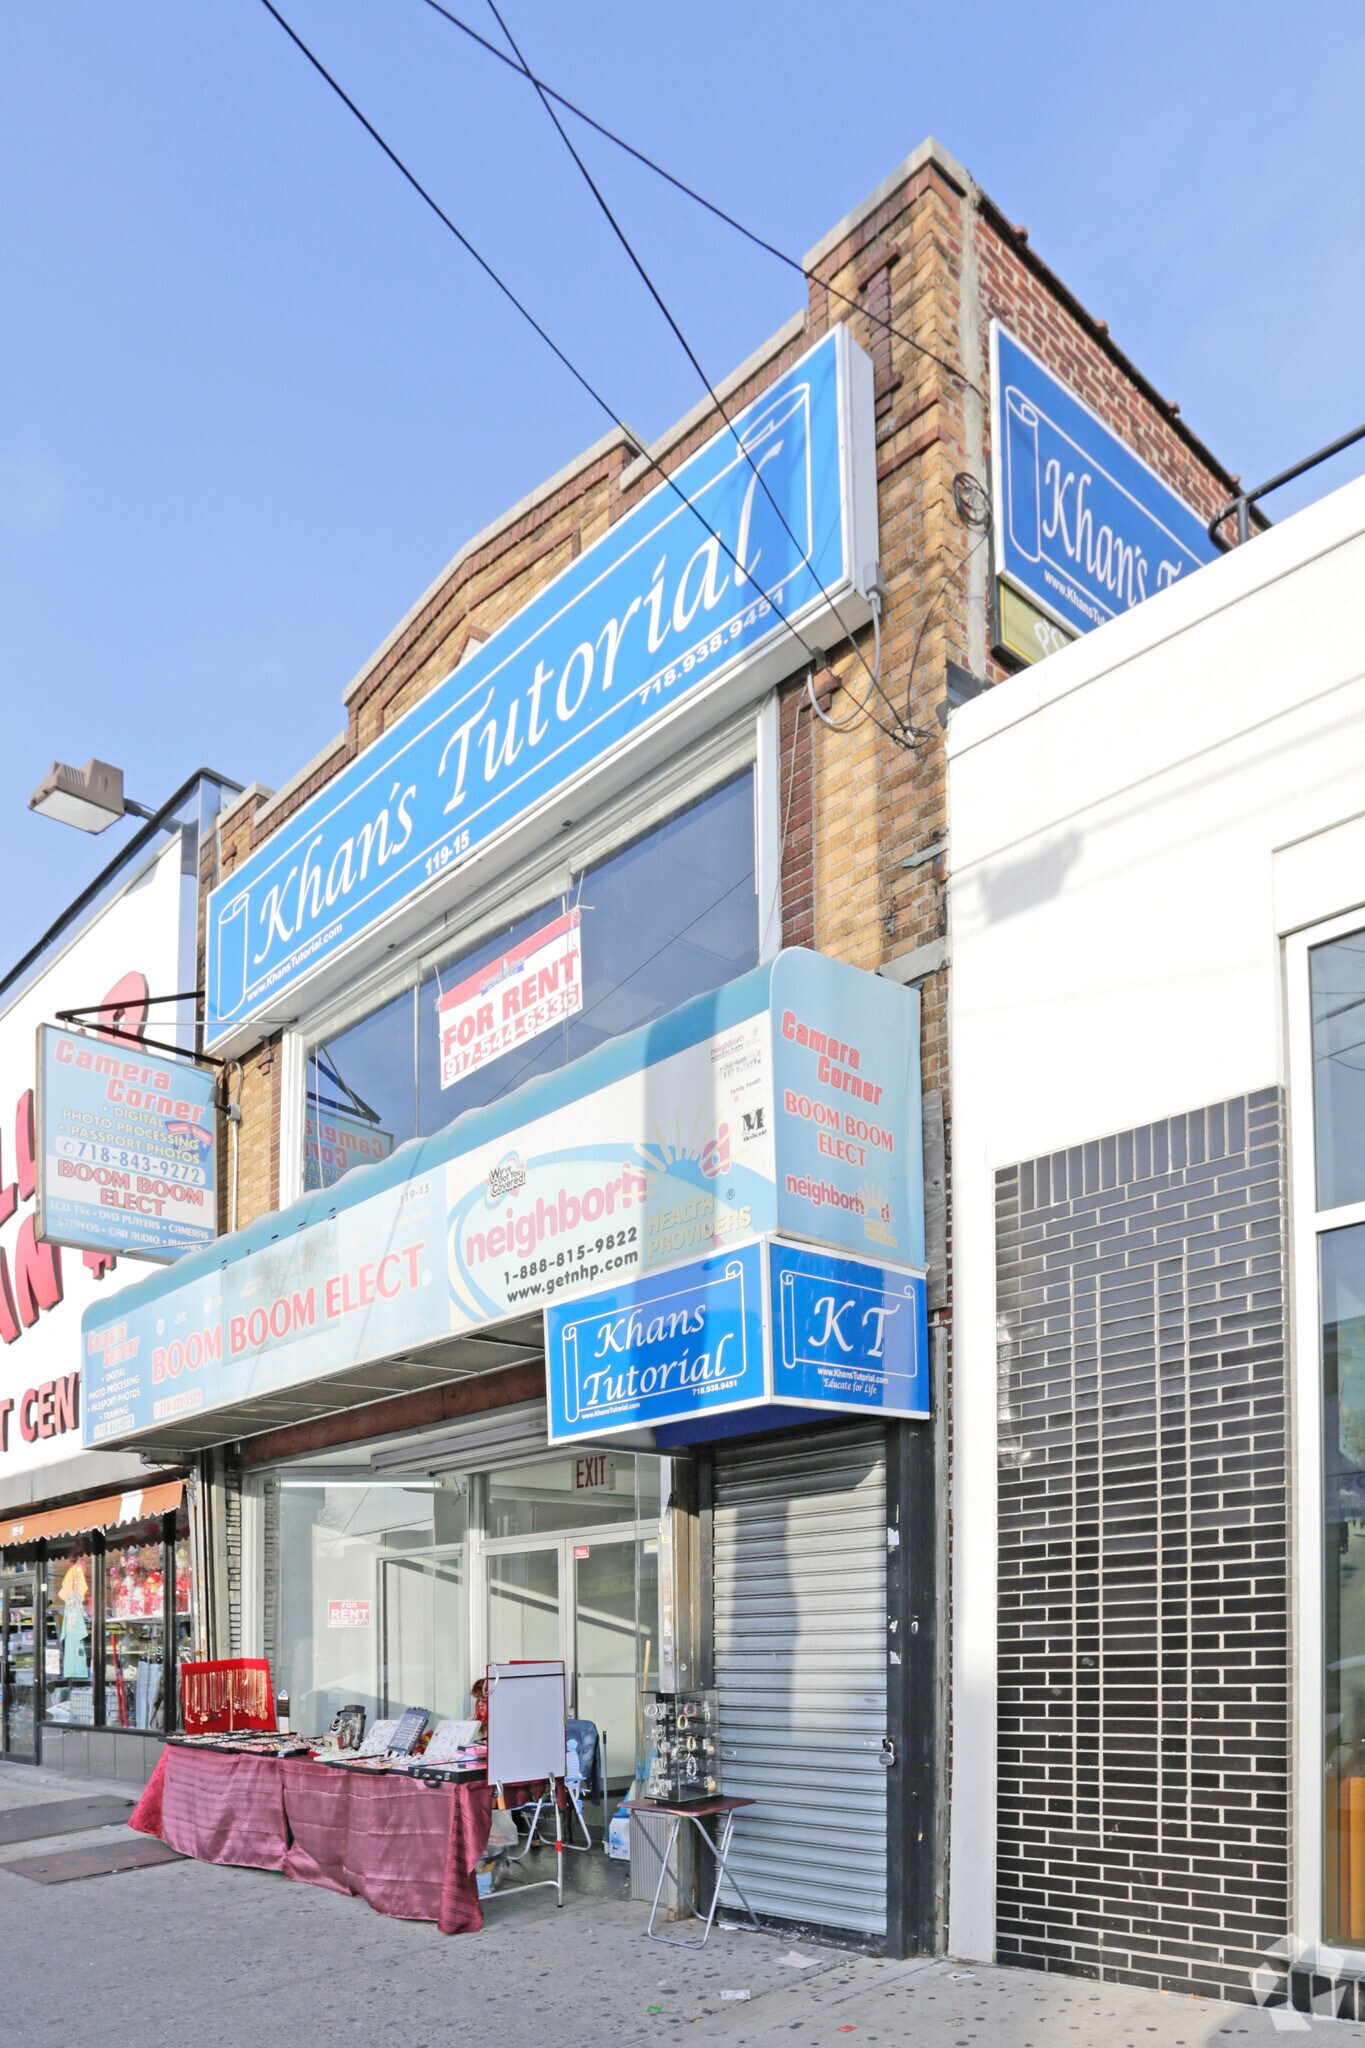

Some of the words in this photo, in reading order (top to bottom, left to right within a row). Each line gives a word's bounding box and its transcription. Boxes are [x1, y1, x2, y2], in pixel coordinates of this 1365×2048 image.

[638, 587, 786, 706] 718.938.9451
[253, 782, 416, 964] Khan's
[438, 439, 784, 814] Tutorial
[425, 829, 470, 876] 119-15
[247, 923, 343, 1002] www.KhansTutorial.com
[443, 1002, 494, 1057] FOR
[502, 948, 579, 1021] RENT
[782, 1010, 860, 1069] Camera
[55, 1038, 171, 1091] Camera
[817, 1055, 882, 1106] Corner
[106, 1077, 205, 1124] Corner
[113, 1107, 166, 1129] DIGITAL
[785, 1090, 840, 1131] BOOM
[845, 1116, 893, 1152] BOOM
[62, 1108, 112, 1130] PHOTO
[116, 1123, 199, 1151] PROCESSING
[71, 1125, 142, 1151] PASSPORT
[146, 1144, 200, 1165] PHOTOS
[819, 1133, 866, 1168] ELECT
[58, 1159, 130, 1190] BOOM
[137, 1176, 204, 1206] BOOM
[77, 1141, 200, 1184] 718-843-9272
[100, 1188, 166, 1216] ELECT
[647, 1193, 715, 1236] HEALTH
[99, 1211, 120, 1222] DVD
[121, 1215, 161, 1231] PLAYERS
[168, 1223, 209, 1240] CAMERAS
[108, 1226, 129, 1239] CAR
[130, 1231, 161, 1246] AUDIO
[647, 1205, 753, 1259] PROVIDERS
[503, 1226, 638, 1285] 1-888-815-9822
[506, 1250, 639, 1303] www.getnhp.com
[152, 1324, 222, 1384] BOOM
[230, 1286, 315, 1354] BOOM
[593, 1303, 706, 1359] Khans
[808, 1296, 856, 1352] K
[861, 1303, 901, 1358] T
[88, 1386, 106, 1401] PHOTO
[106, 1374, 140, 1394] PROCESSING
[105, 1367, 125, 1382] DIGITAL
[582, 1333, 734, 1406] Tutorial
[692, 1380, 738, 1396] 718.938.9451
[817, 1367, 889, 1385] www.KhansTutorial.com
[823, 1377, 852, 1391] Educate
[852, 1381, 864, 1393] for
[864, 1384, 877, 1397] Life
[91, 1395, 117, 1412] PASSPORT
[117, 1386, 141, 1404] PHOTOS
[103, 1404, 129, 1421] FRAMING
[581, 1402, 641, 1420] www.KhansTutorial.com
[576, 1455, 607, 1489] EXIT
[330, 1609, 369, 1619] RENT
